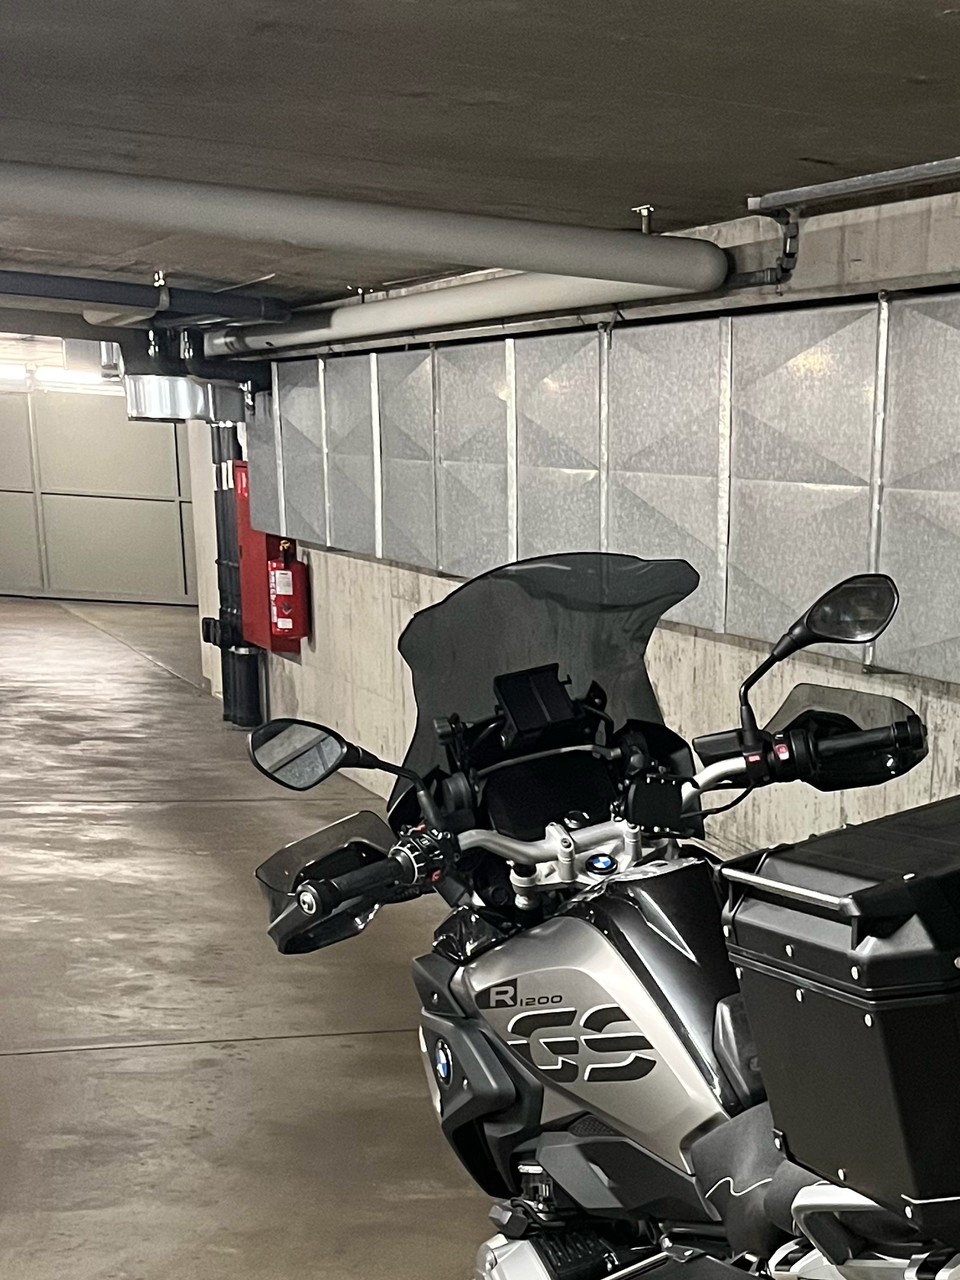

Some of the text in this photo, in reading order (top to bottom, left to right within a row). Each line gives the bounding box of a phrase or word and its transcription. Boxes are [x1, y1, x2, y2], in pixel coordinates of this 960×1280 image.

[489, 985, 563, 1008] R 1200
[506, 1002, 657, 1083] GS
